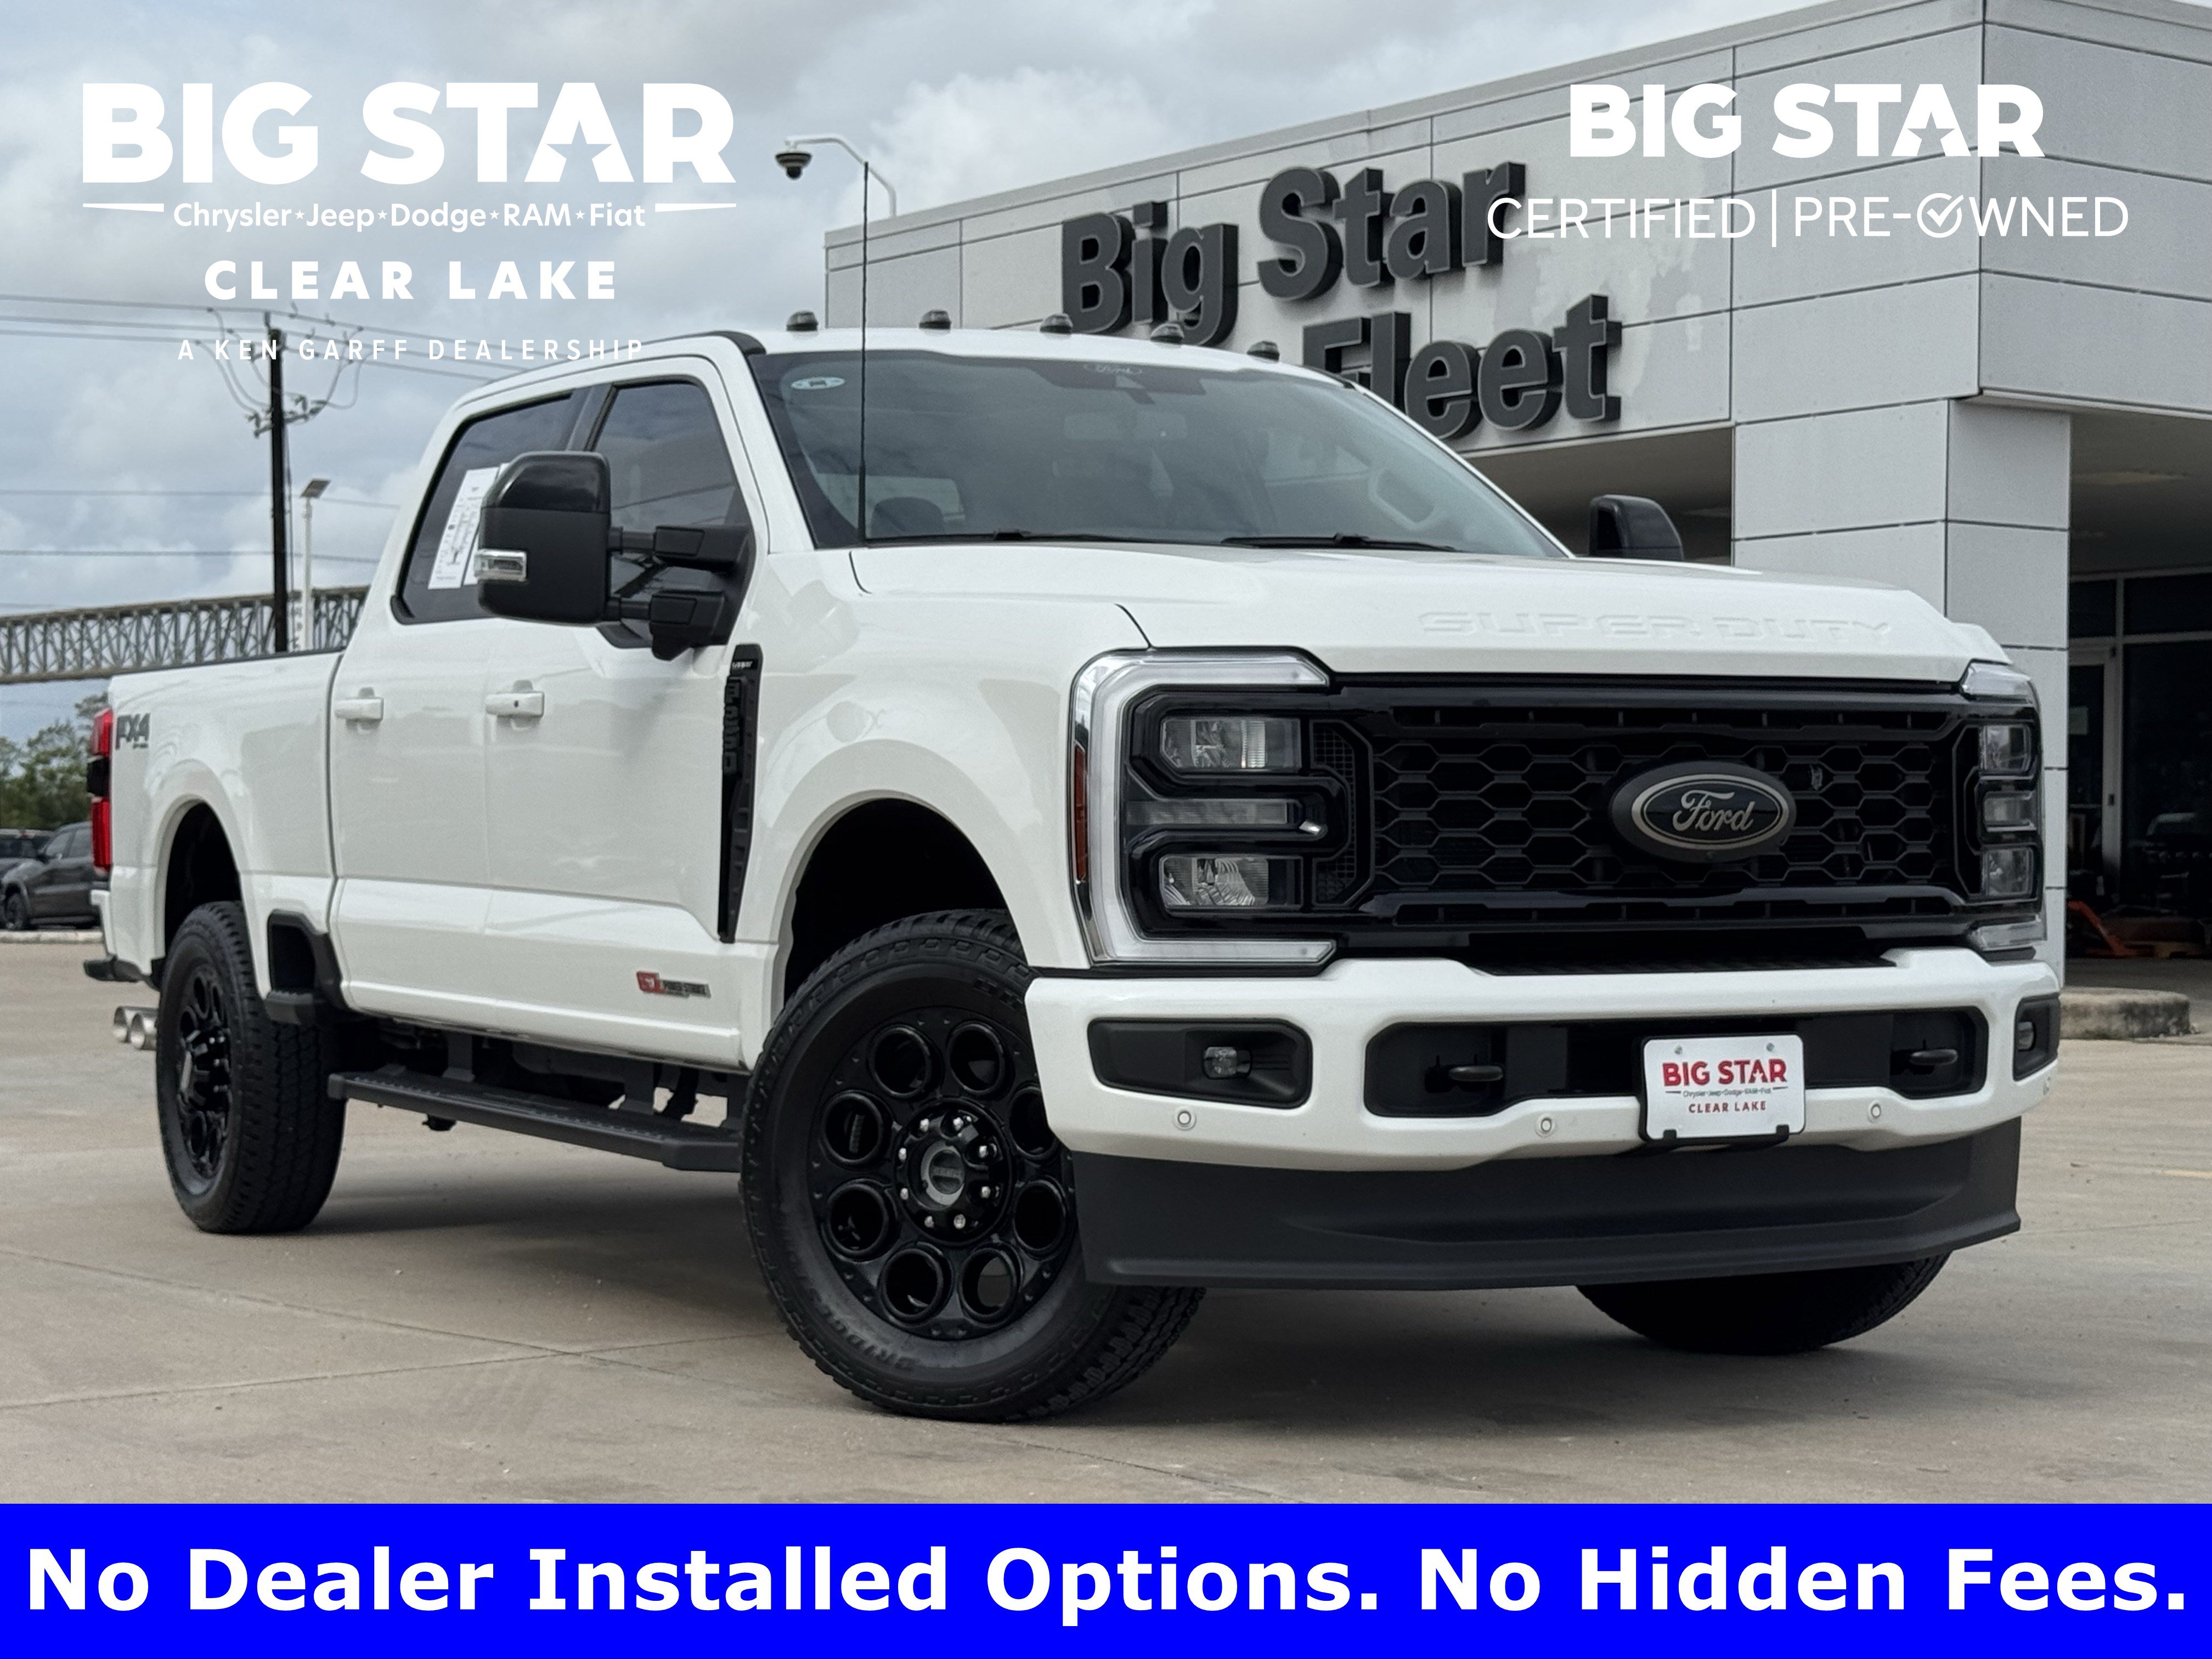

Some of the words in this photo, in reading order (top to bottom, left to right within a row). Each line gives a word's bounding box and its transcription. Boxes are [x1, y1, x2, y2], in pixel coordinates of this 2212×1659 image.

[1061, 201, 1238, 348] Big
[1257, 162, 1526, 301] Star
[1303, 294, 1622, 438] Fleet
[1417, 610, 1702, 643] SUPER
[1712, 616, 1891, 645] DUTY
[1672, 789, 1755, 831] Ford
[1662, 1060, 1710, 1087] BIG
[1718, 1058, 1787, 1085] STAR
[1689, 1102, 1729, 1114] CLEAR
[1735, 1101, 1767, 1111] LAKE
